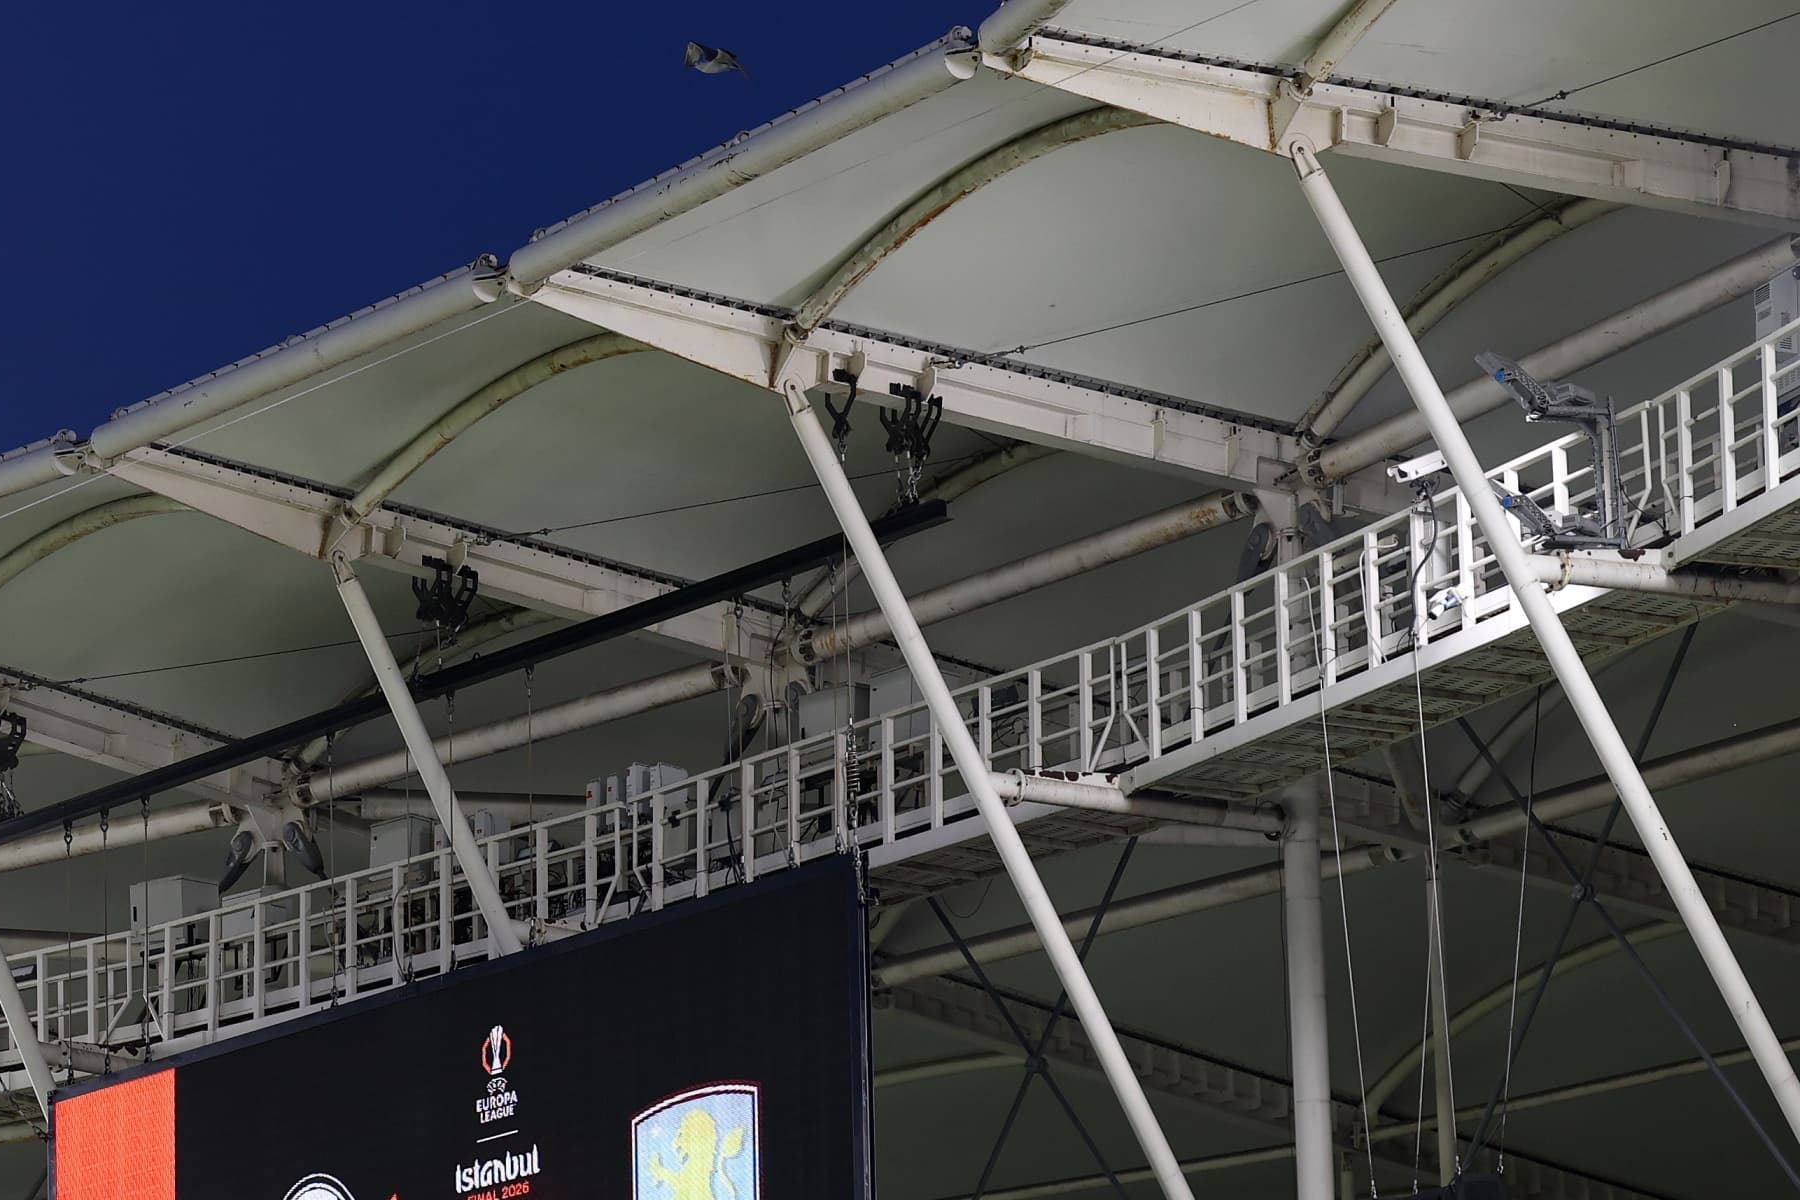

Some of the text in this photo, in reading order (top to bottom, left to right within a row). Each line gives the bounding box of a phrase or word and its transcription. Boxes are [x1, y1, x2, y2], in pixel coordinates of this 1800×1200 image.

[476, 1091, 518, 1113] EUROPA
[480, 1107, 515, 1124] LEAGUE
[501, 1180, 530, 1199] 2026
